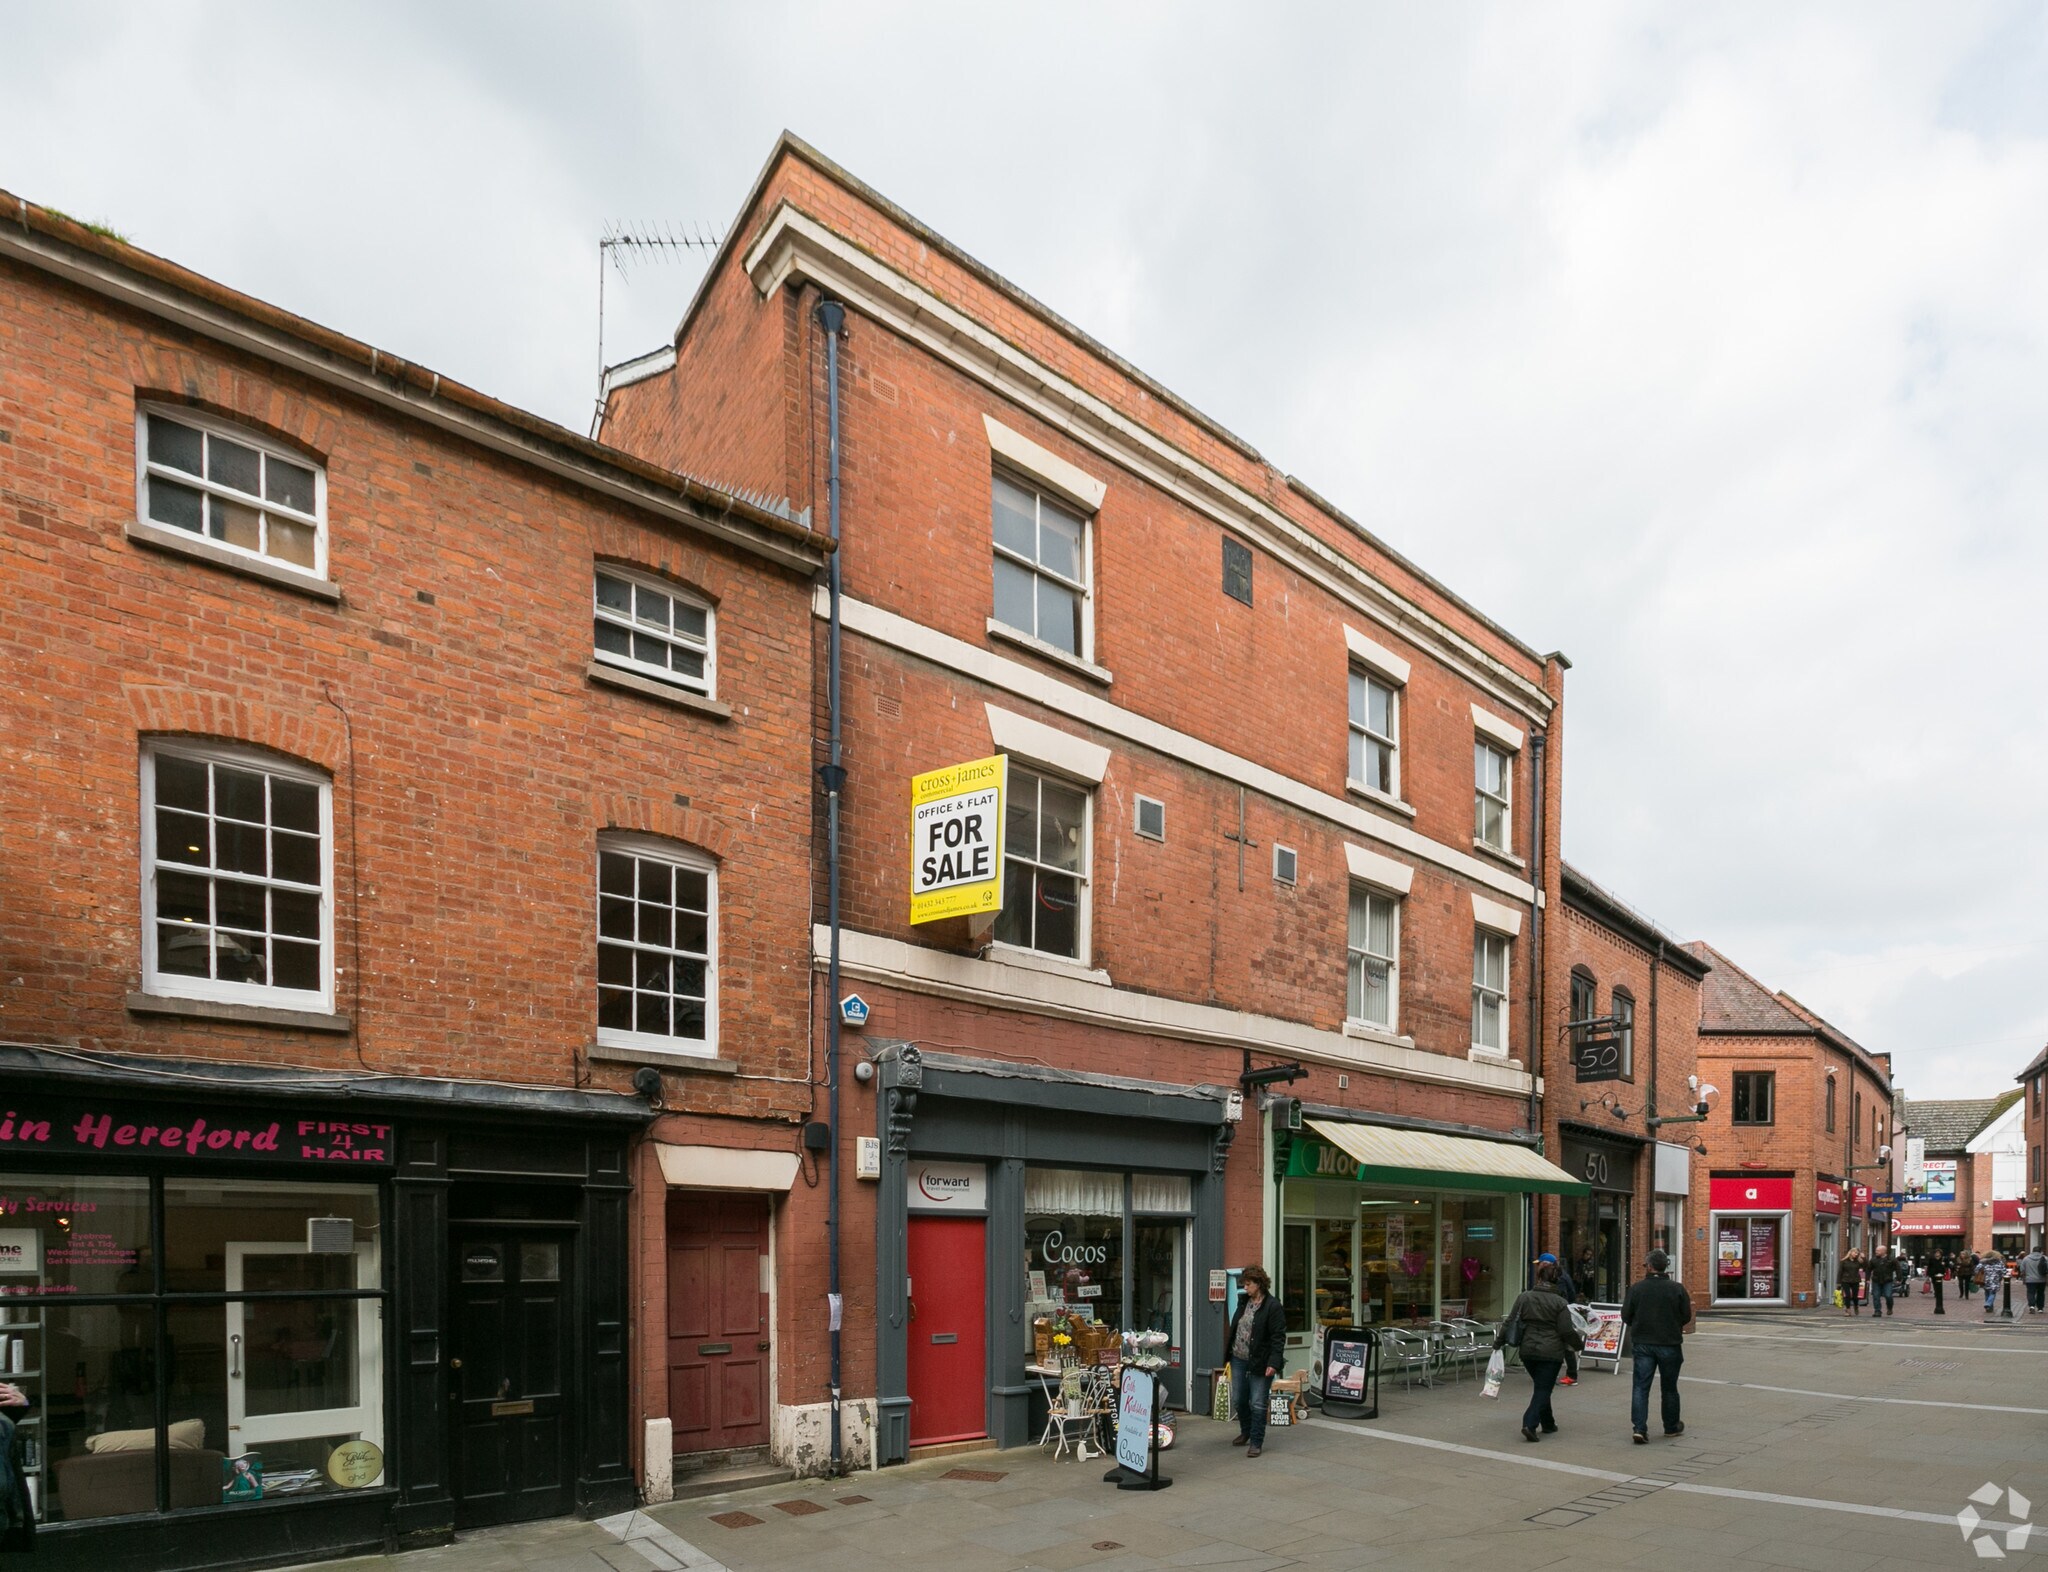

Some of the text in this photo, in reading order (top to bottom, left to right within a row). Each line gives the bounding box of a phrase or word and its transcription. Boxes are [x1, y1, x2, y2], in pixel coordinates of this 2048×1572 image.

[917, 794, 995, 820] OFFICE & FLAT
[929, 813, 983, 853] FOR
[921, 846, 990, 887] SALE
[1578, 1046, 1618, 1068] 50
[0, 1111, 280, 1155] in Hereford
[298, 1121, 391, 1139] FIRST
[331, 1135, 354, 1150] 4
[865, 1141, 879, 1149] BJS
[302, 1146, 384, 1161] HAIR
[1586, 1152, 1608, 1184] 50
[926, 1175, 970, 1187] forward
[25, 1197, 97, 1213] Services
[71, 1233, 112, 1241] Eyebrow
[98, 1241, 118, 1249] Tidy
[1043, 1230, 1106, 1263] Cocos
[47, 1249, 136, 1257] Wedding Packages
[47, 1257, 63, 1265] Gel
[1753, 1282, 1770, 1292] 99p
[1270, 1400, 1288, 1408] BEST
[1119, 1438, 1145, 1467] Cocos
